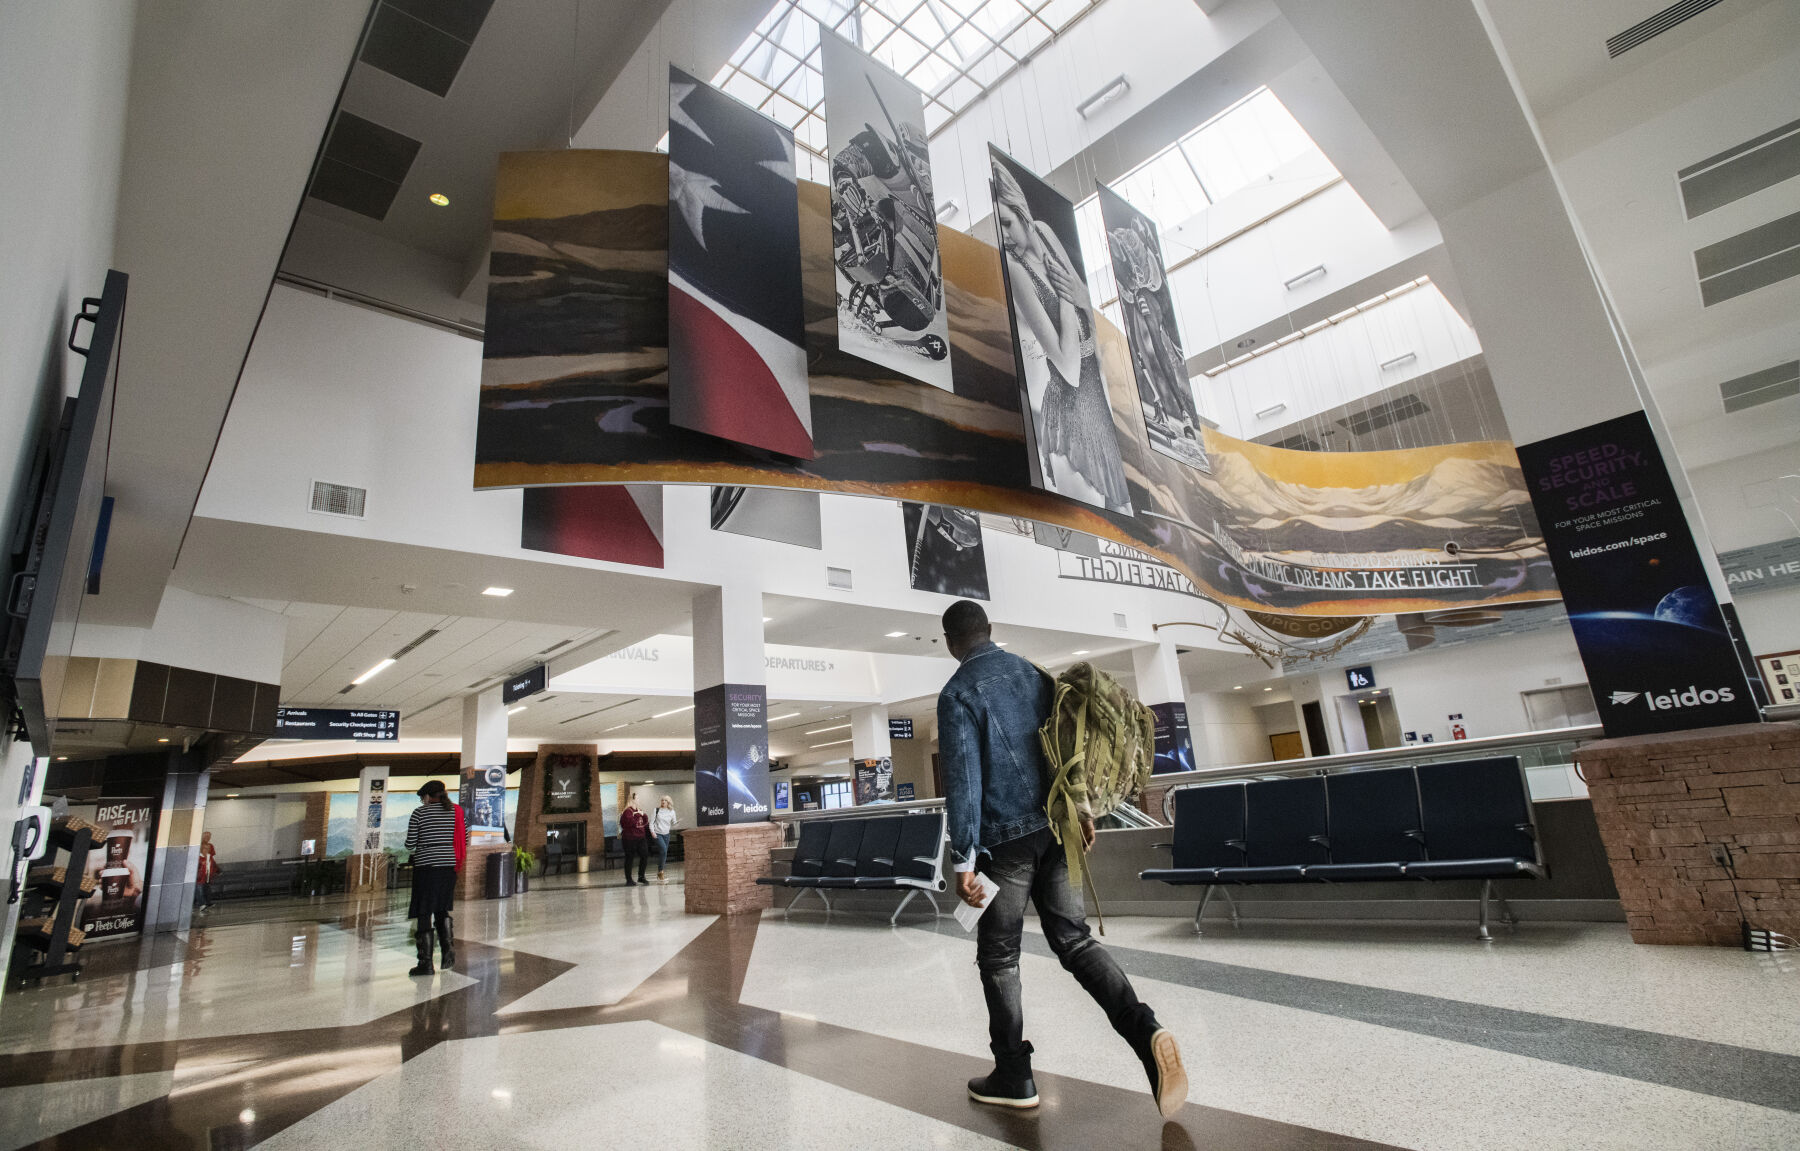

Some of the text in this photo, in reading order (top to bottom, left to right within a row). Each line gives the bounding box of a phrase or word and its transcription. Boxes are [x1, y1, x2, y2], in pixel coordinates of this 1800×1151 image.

[1550, 444, 1625, 473] SPEED,
[1539, 451, 1649, 492] SECURITY,
[1583, 478, 1611, 492] AND
[1566, 482, 1638, 511] SCALE
[1554, 498, 1662, 529] FOR YOUR MOST CRITICAL
[1575, 510, 1645, 532] SPACE MISSIONS
[1569, 531, 1668, 559] leidos.com/space
[1384, 553, 1441, 567] SPRINGS
[1295, 566, 1355, 589] DREAMS
[1357, 570, 1409, 588] TAKE
[1411, 569, 1472, 588] FLIGHT
[729, 693, 762, 701] SECURITY
[1644, 685, 1736, 712] leidos
[97, 804, 127, 822] RISE
[124, 807, 150, 825] FLY!
[708, 806, 724, 816] leidos
[743, 804, 768, 813] leidos
